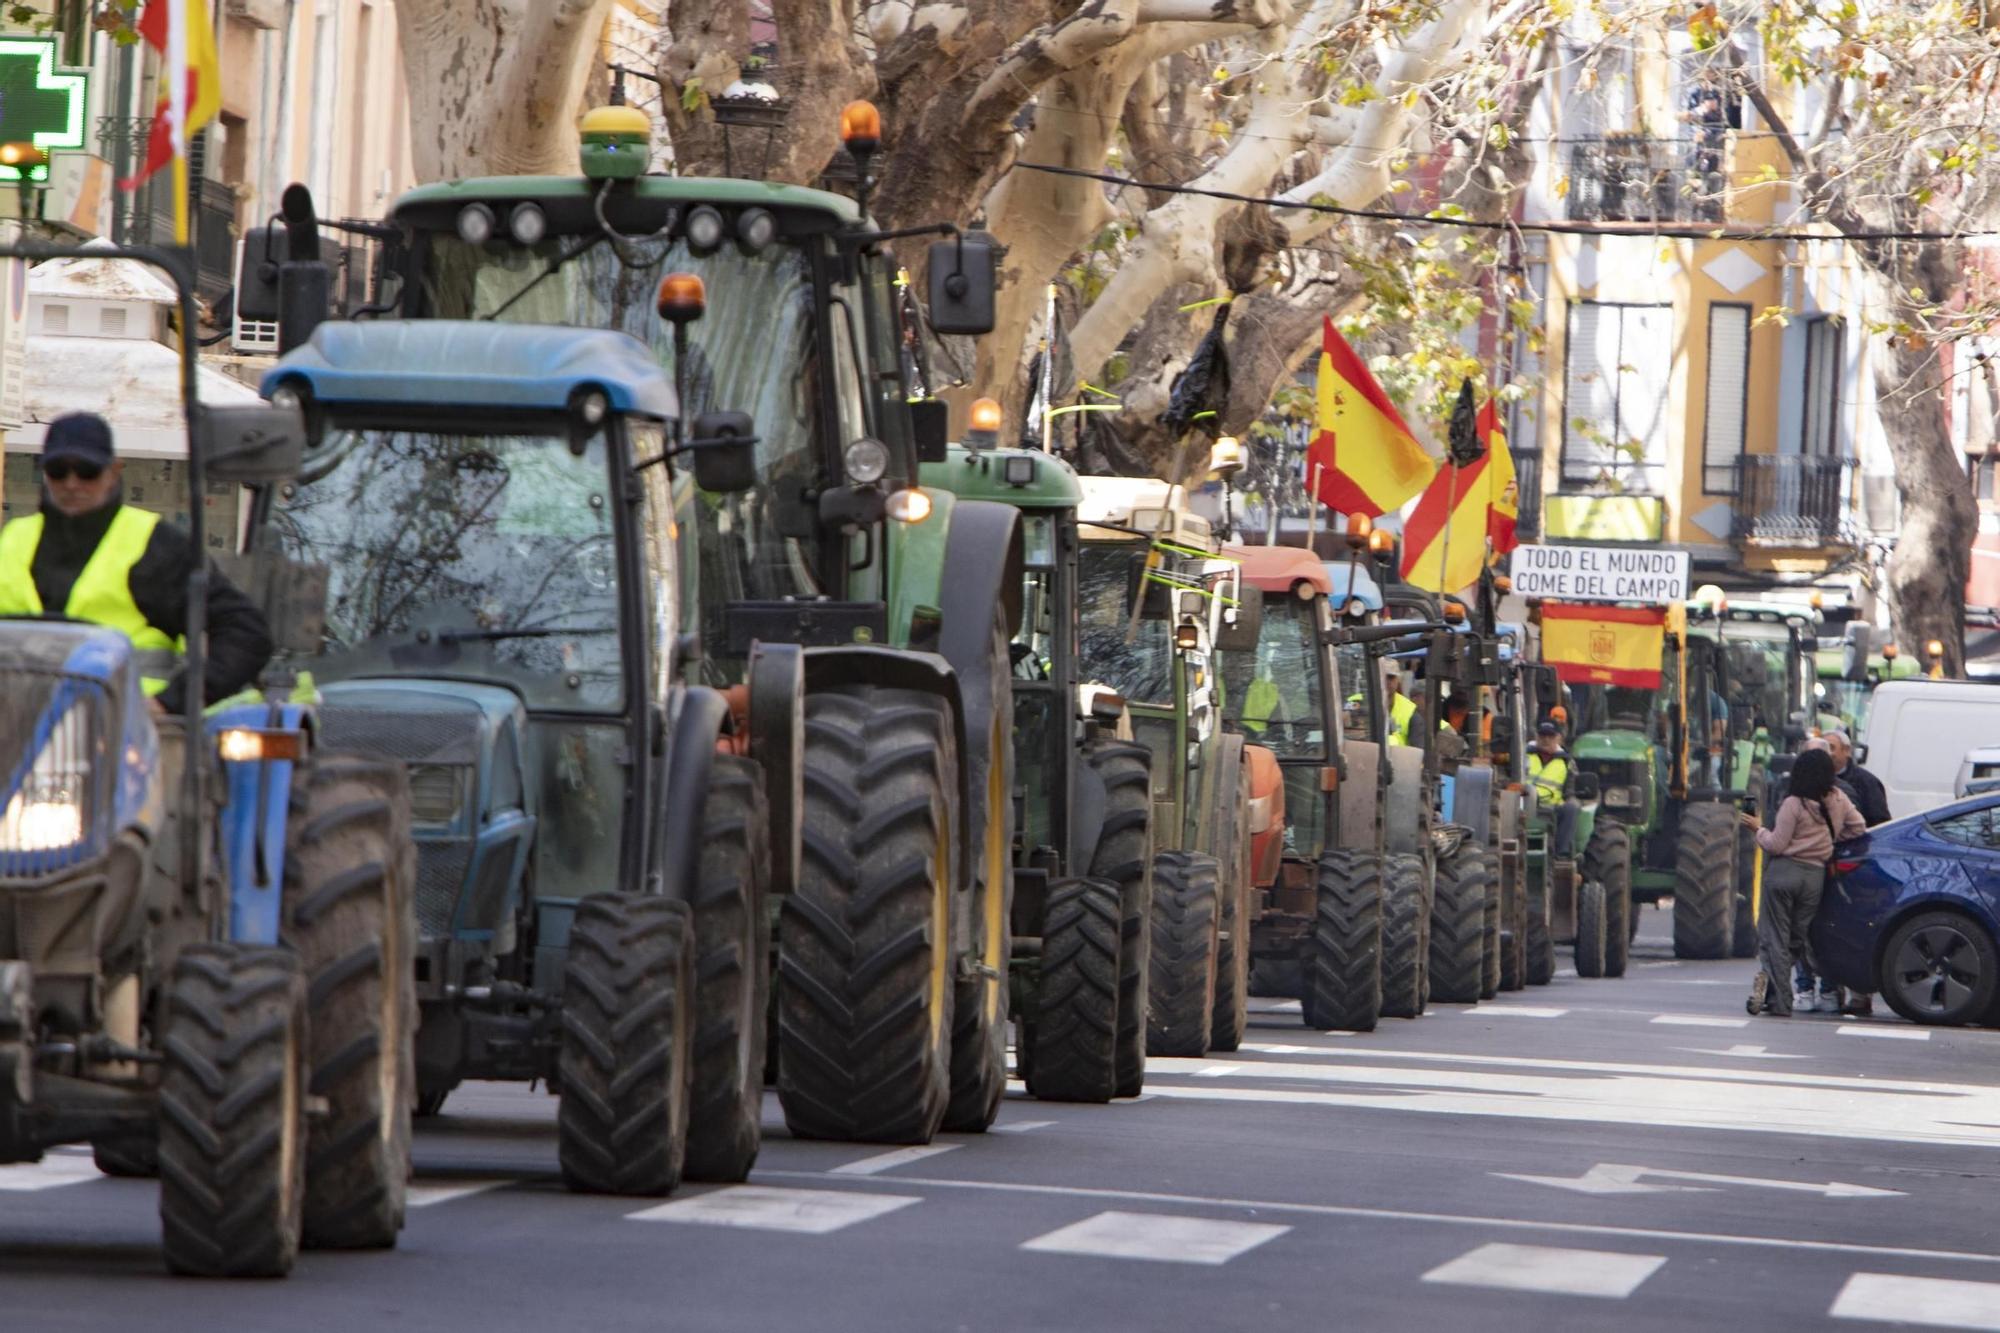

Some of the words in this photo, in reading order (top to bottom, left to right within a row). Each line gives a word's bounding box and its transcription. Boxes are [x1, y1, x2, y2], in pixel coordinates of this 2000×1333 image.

[1525, 548, 1572, 569] TODO
[1580, 551, 1600, 571] EL
[1608, 552, 1676, 574] MUNDO
[1516, 572, 1568, 594] COME
[1575, 575, 1608, 596] DEL
[1616, 577, 1680, 599] CAMPO
